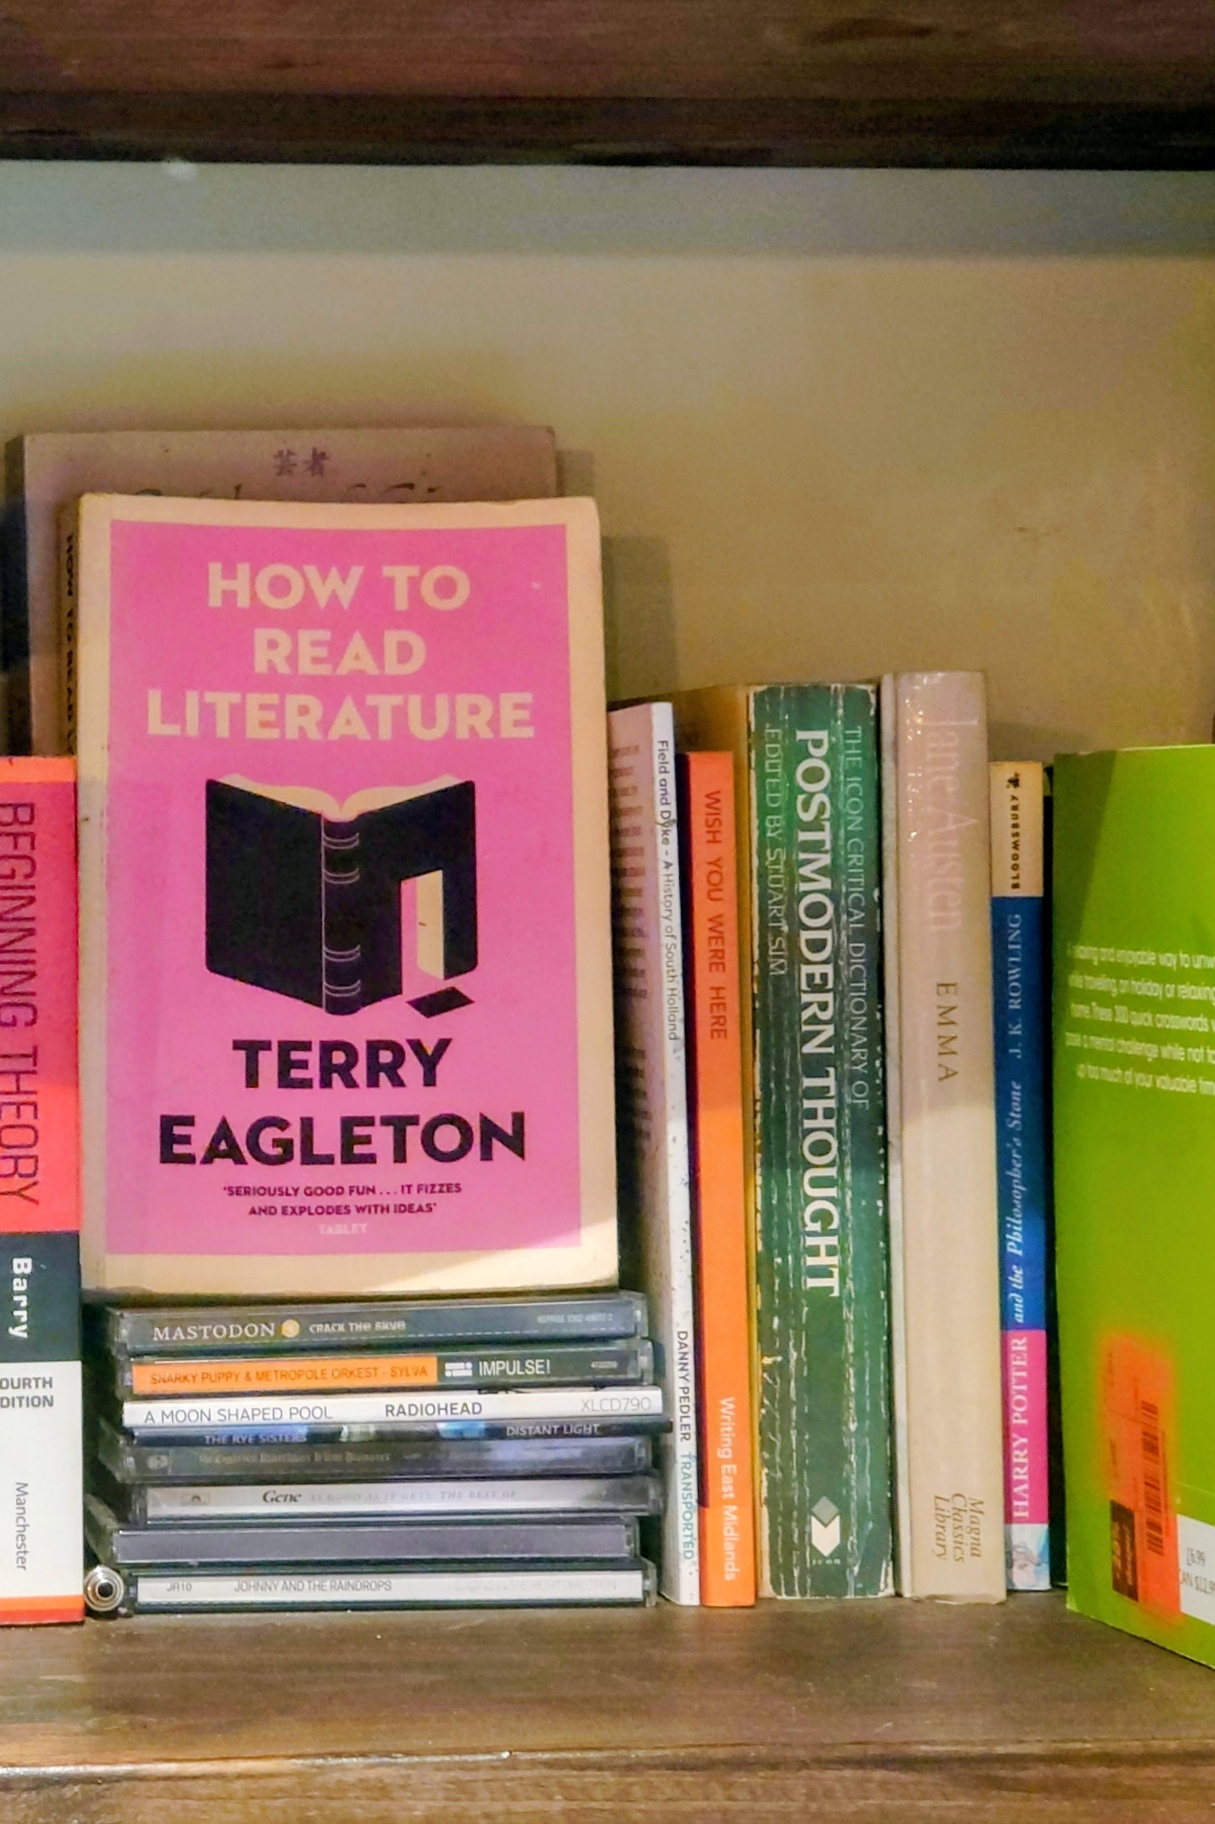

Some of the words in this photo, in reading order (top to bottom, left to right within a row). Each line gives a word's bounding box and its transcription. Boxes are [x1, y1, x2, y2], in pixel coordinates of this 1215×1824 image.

[208, 562, 363, 610] HOW
[383, 564, 471, 611] TO
[253, 629, 427, 675] READ
[148, 689, 535, 740] LITERATURE
[844, 725, 863, 773] THE
[704, 790, 724, 845] WISH
[845, 776, 864, 832] ICON
[1010, 794, 1021, 890] BLOOMSBURY
[705, 856, 725, 903] YOU
[796, 728, 836, 1054] POSTMODERN
[846, 836, 866, 930] CRITICAL
[706, 914, 726, 974] WERE
[1007, 914, 1023, 1010] ROWLING
[708, 985, 727, 1040] HERE
[848, 943, 869, 1073] DICTIONARY
[936, 981, 959, 1083] EMMA
[233, 1038, 452, 1090] TERRY
[851, 1079, 870, 1109] OF
[1007, 1080, 1023, 1130] Stone
[159, 1111, 525, 1166] EAGLETON
[303, 1186, 345, 1197] GOOD
[348, 1185, 377, 1196] FUN
[400, 1184, 413, 1195] IT
[416, 1183, 463, 1194] FIZZES
[802, 1066, 841, 1297] THOUGHT
[248, 1205, 278, 1216] AND
[281, 1205, 351, 1216] EXPLODES
[354, 1204, 390, 1215] WITH
[9, 1257, 33, 1339] Barry
[1007, 1264, 1023, 1288] the
[1008, 1292, 1026, 1323] and
[150, 1372, 198, 1385] SNARKY
[201, 1371, 241, 1384] PUPPY
[243, 1370, 253, 1382] &
[255, 1368, 328, 1382] METROPOLE
[331, 1367, 380, 1380] ORKEST
[390, 1365, 428, 1378] SYLVA
[479, 1359, 551, 1376] IMPULSE!
[677, 1330, 690, 1383] DANNY
[1011, 1336, 1028, 1425] POTTER
[144, 1410, 156, 1424] A
[161, 1409, 212, 1424] MOON
[217, 1407, 283, 1422] SHAPED
[289, 1406, 333, 1421] POOL
[385, 1402, 483, 1418] RADIOHEAD
[580, 1397, 652, 1413] XLCD790
[678, 1386, 692, 1442] PEDLER
[715, 1396, 738, 1459] Writing
[720, 1463, 738, 1499] East
[1013, 1436, 1030, 1518] HARRY
[14, 1481, 30, 1571] Manchester
[680, 1451, 696, 1560] TRANSPORTED
[933, 1495, 951, 1560] Library
[950, 1492, 968, 1563] Classics
[968, 1496, 986, 1558] Magna
[721, 1505, 740, 1582] Midlands
[234, 1581, 279, 1592] JOHNNY
[282, 1581, 305, 1592] AND
[307, 1581, 327, 1591] THE
[330, 1580, 392, 1591] RAINDROPS
